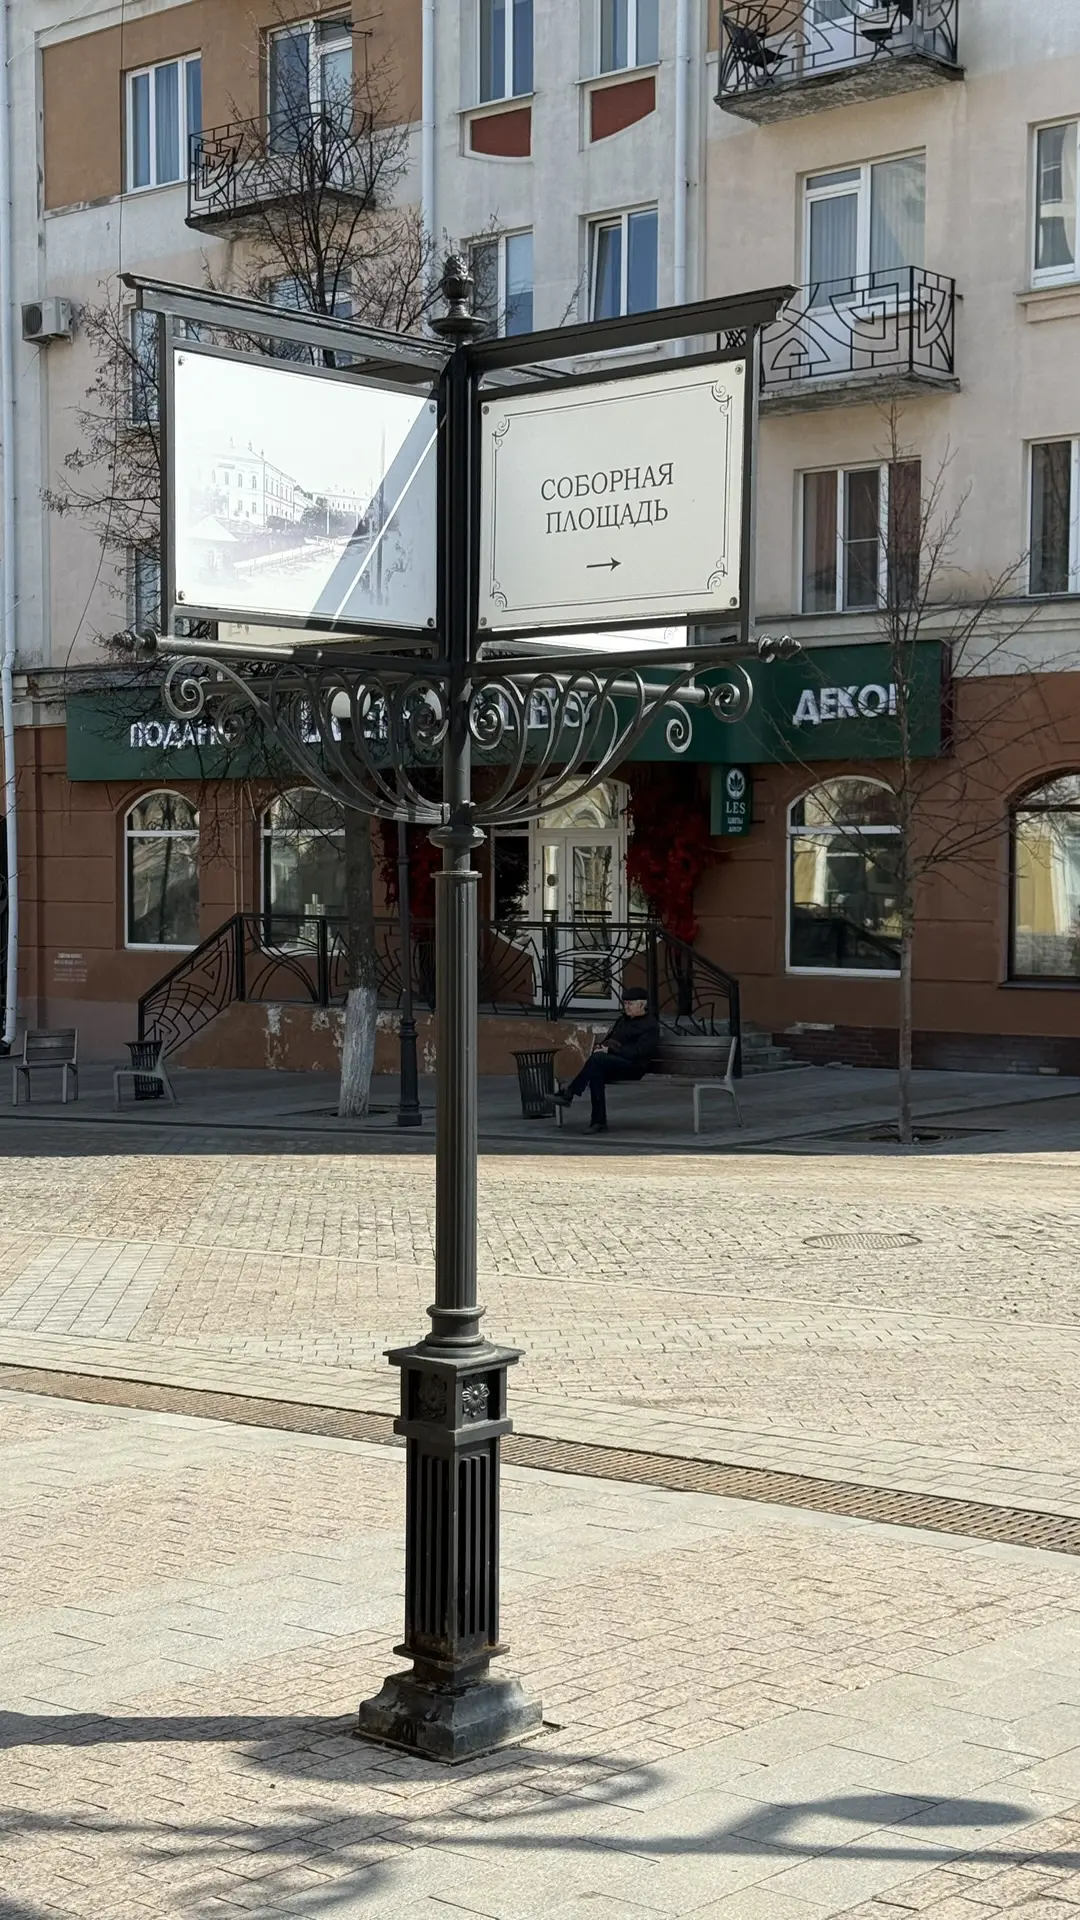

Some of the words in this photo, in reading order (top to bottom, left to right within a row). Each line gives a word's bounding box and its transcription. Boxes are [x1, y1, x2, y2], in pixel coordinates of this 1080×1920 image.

[540, 461, 674, 501] СОБОРНАЯ
[545, 498, 668, 534] ПЛОЩАДЬ
[726, 801, 746, 814] LES
